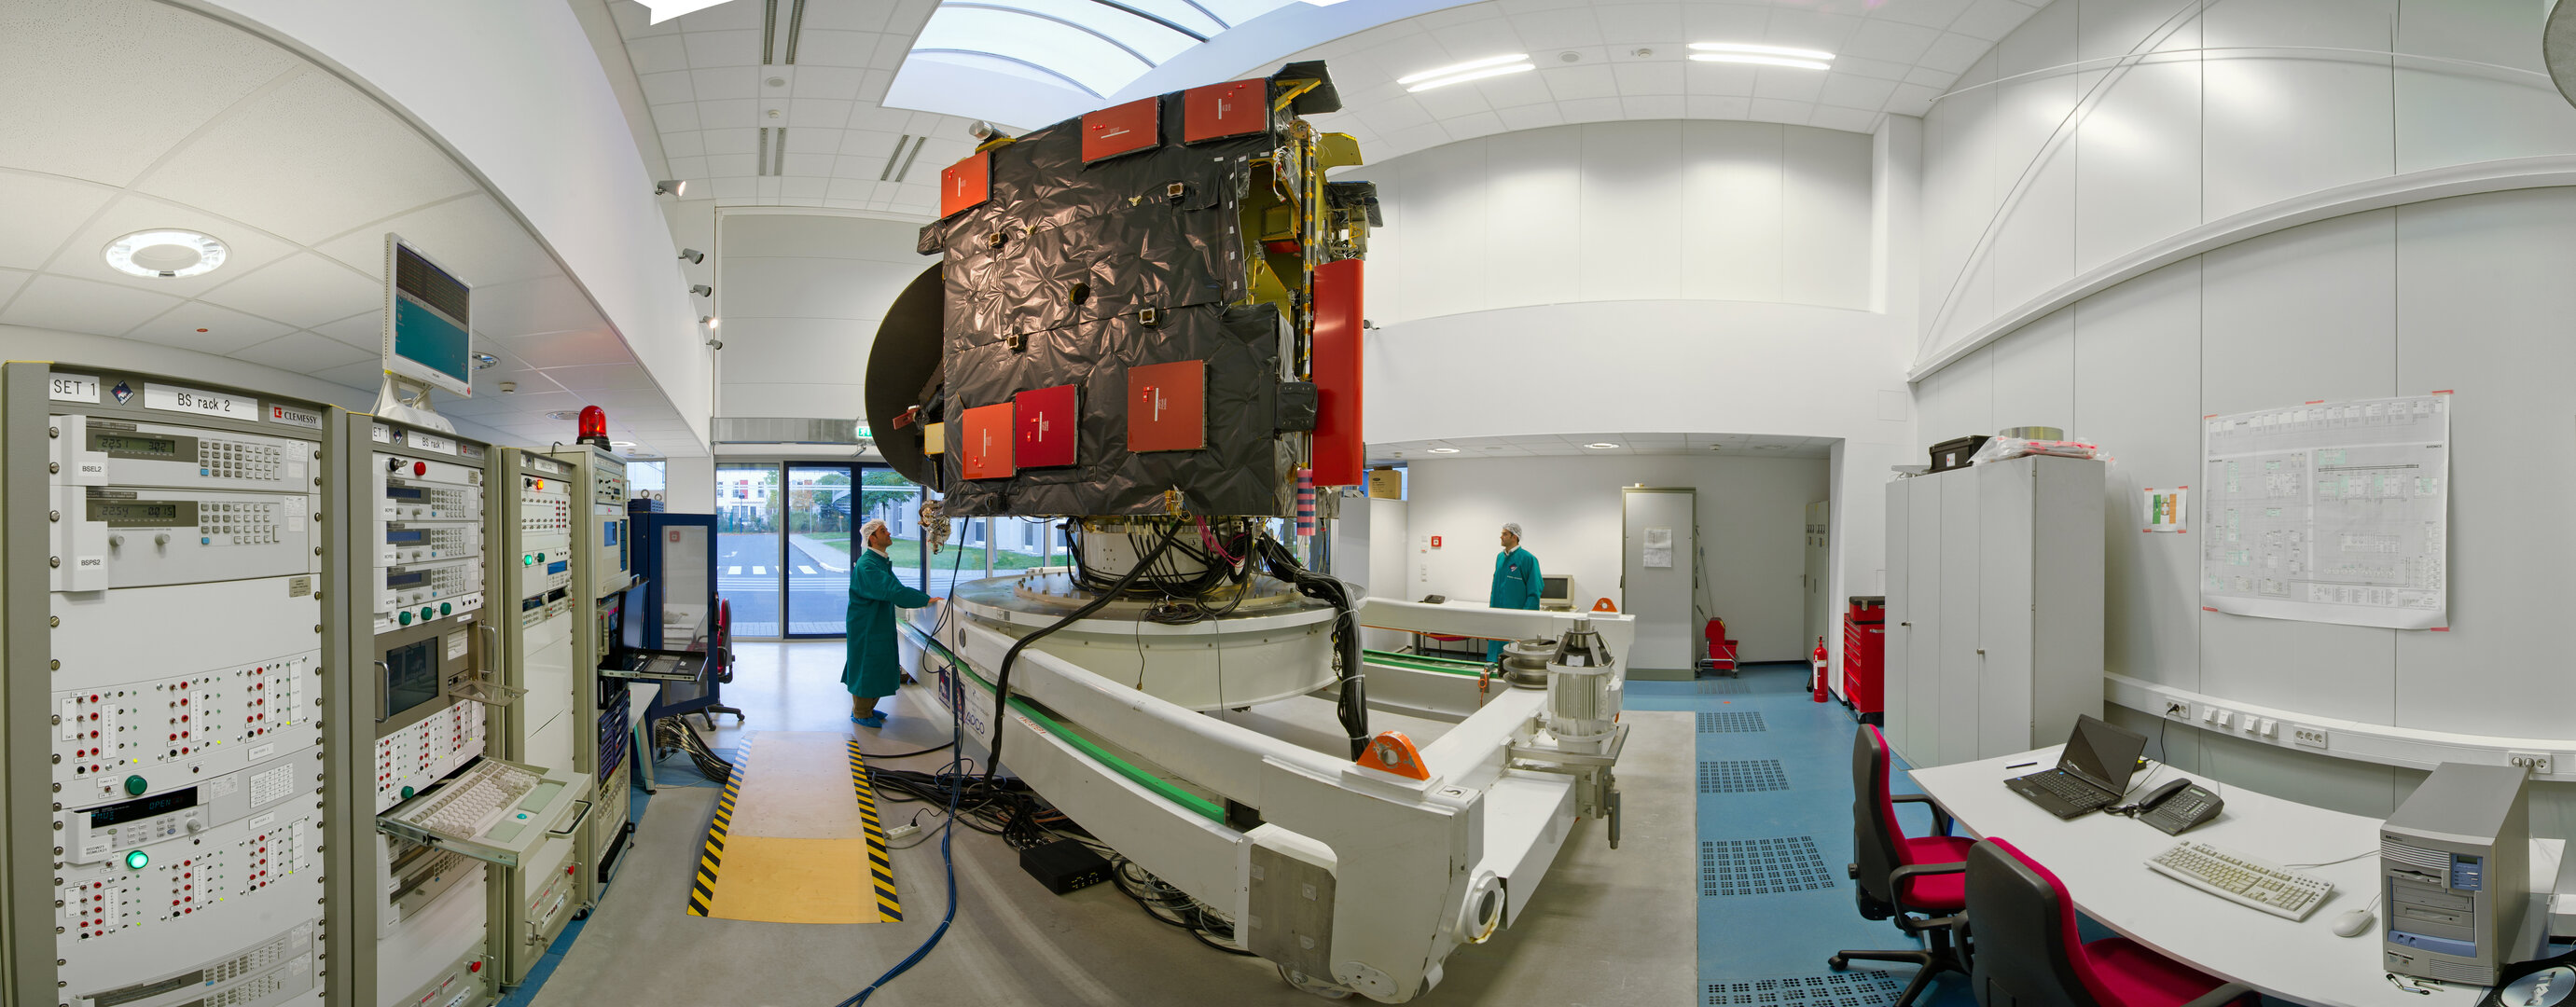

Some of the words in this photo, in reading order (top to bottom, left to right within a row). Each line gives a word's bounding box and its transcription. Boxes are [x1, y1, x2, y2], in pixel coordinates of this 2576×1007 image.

[53, 379, 82, 394] SET
[90, 383, 95, 395] 1
[177, 393, 192, 407] BS
[198, 398, 219, 410] rack
[224, 399, 230, 412] 2
[284, 412, 318, 424] CLEMESSY
[373, 427, 381, 439] ET
[422, 436, 429, 447] BS
[430, 439, 440, 449] rack
[441, 441, 445, 449] 1
[149, 799, 171, 810] OPEN
